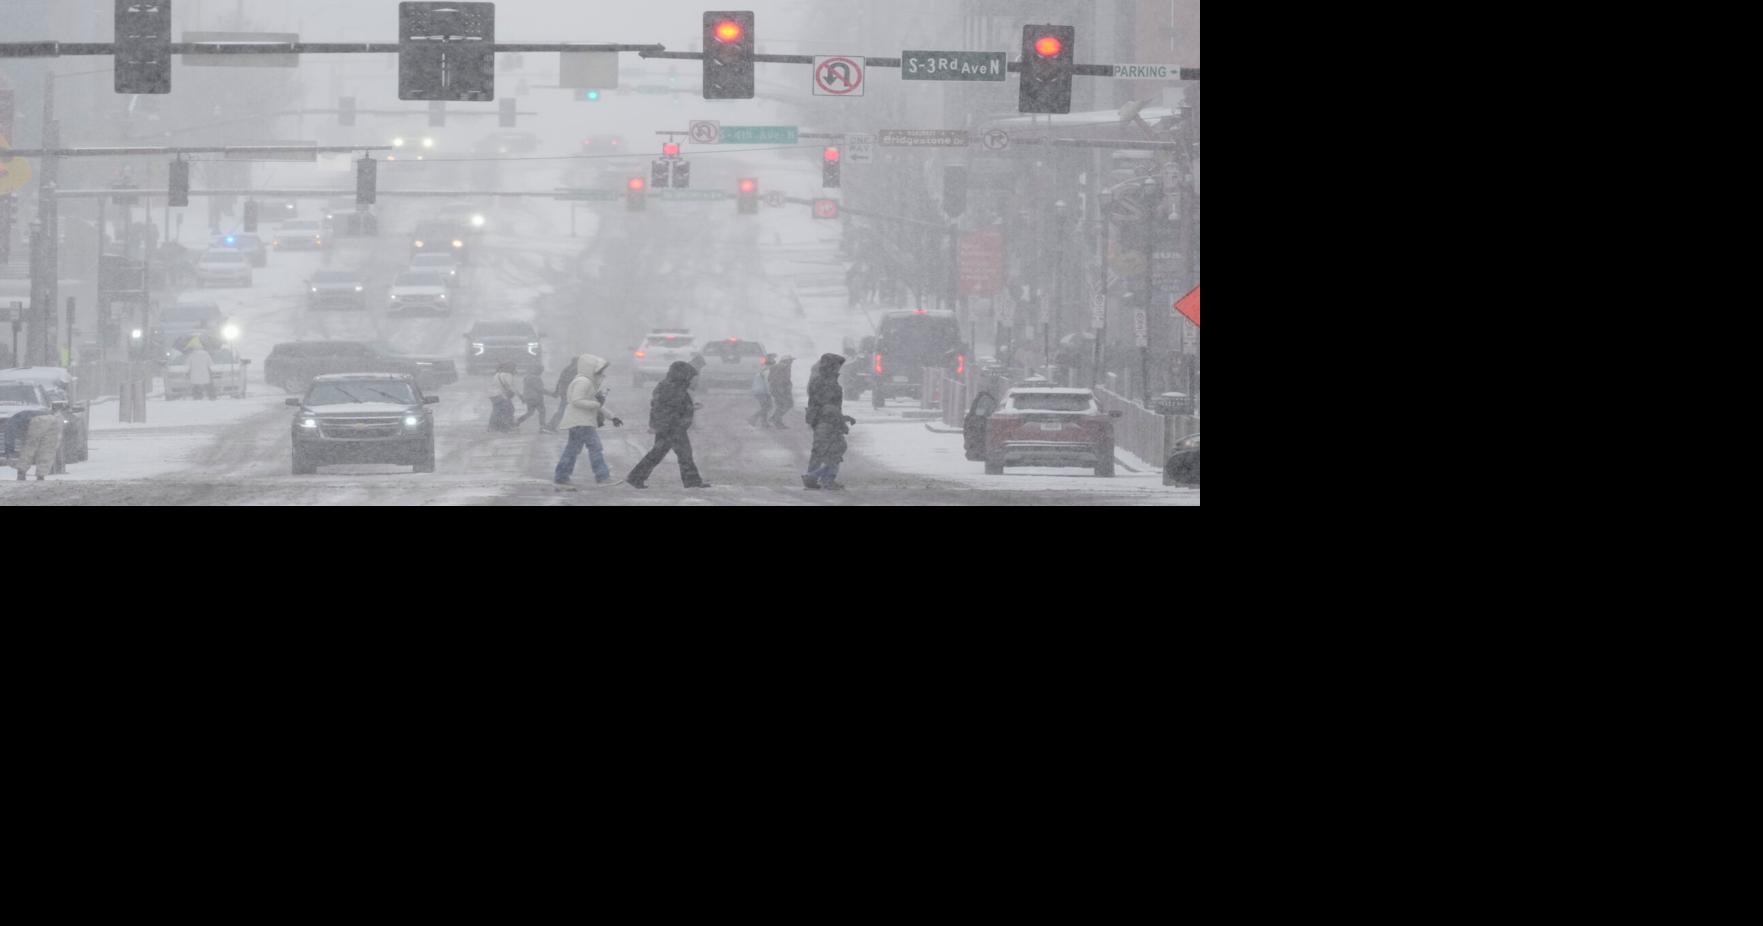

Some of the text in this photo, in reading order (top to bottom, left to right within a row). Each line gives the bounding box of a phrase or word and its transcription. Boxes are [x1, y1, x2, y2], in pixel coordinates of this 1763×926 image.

[961, 62, 987, 74] Ave
[990, 59, 1000, 74] N
[1114, 66, 1167, 77] PARKING
